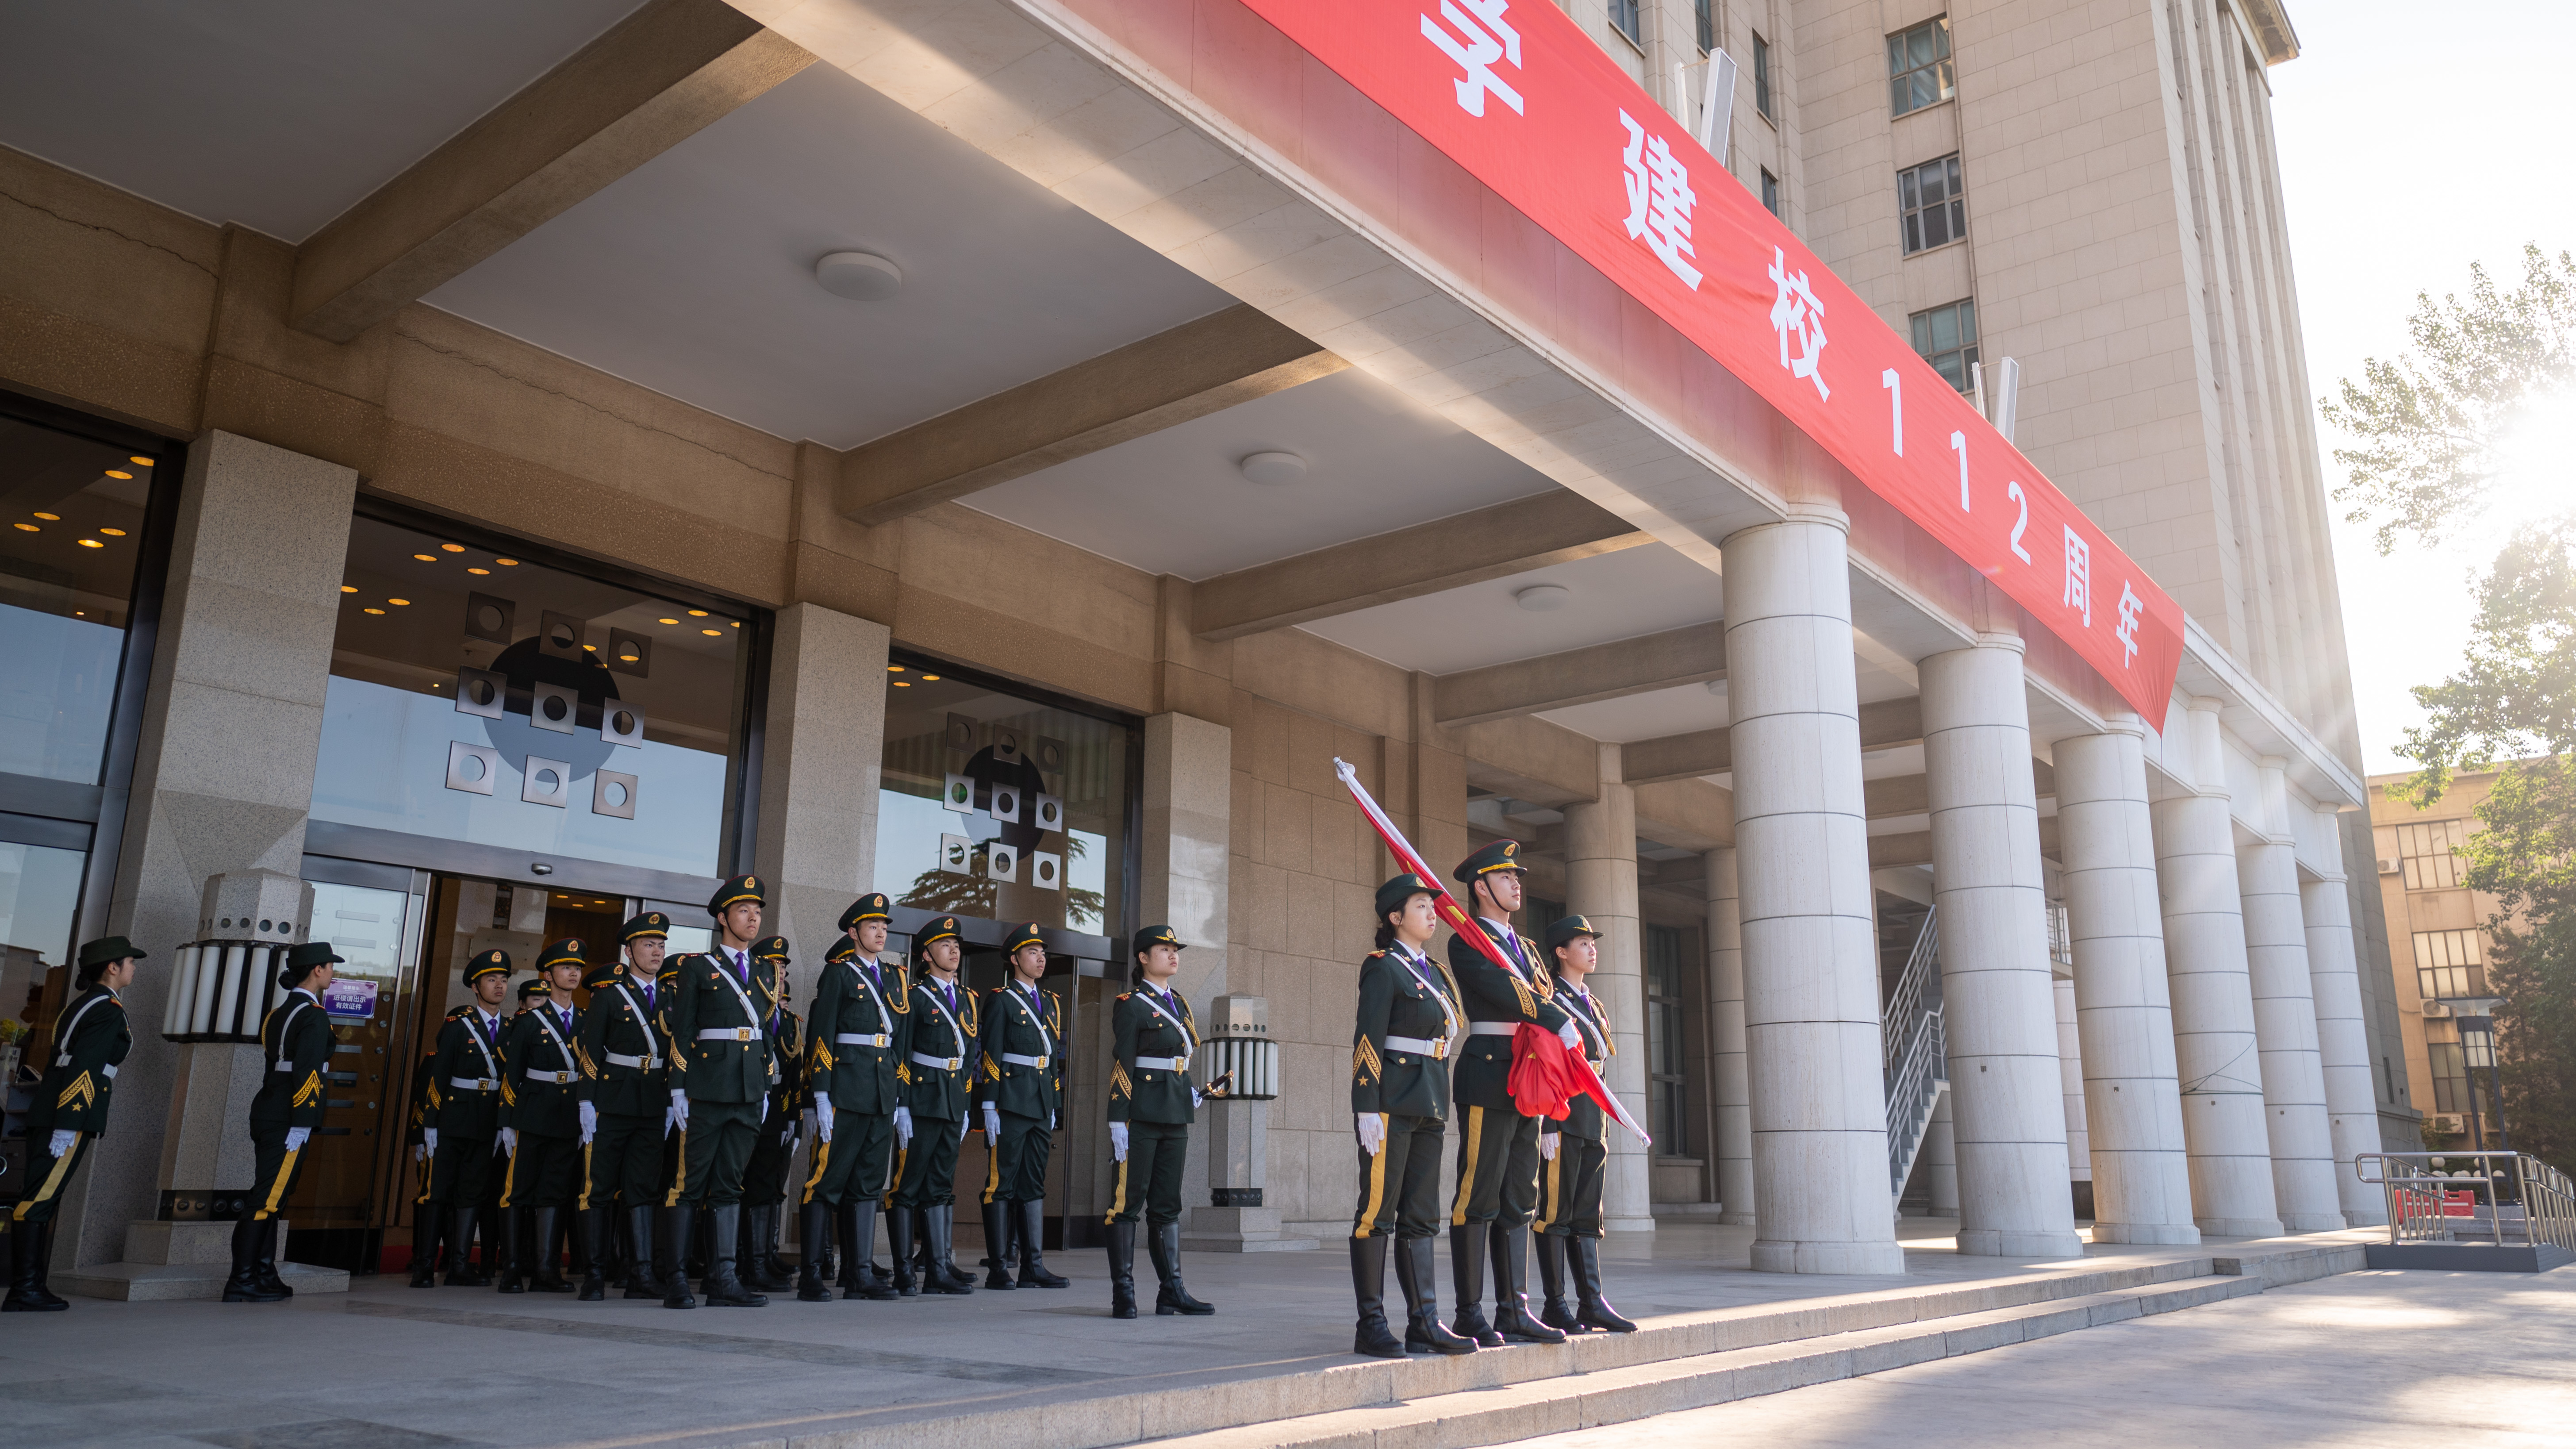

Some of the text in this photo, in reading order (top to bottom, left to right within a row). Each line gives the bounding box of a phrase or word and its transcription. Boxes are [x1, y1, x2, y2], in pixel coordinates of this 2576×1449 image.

[1420, 0, 2143, 669] 学建校112周年
[333, 994, 366, 1003] 进楼请出示
